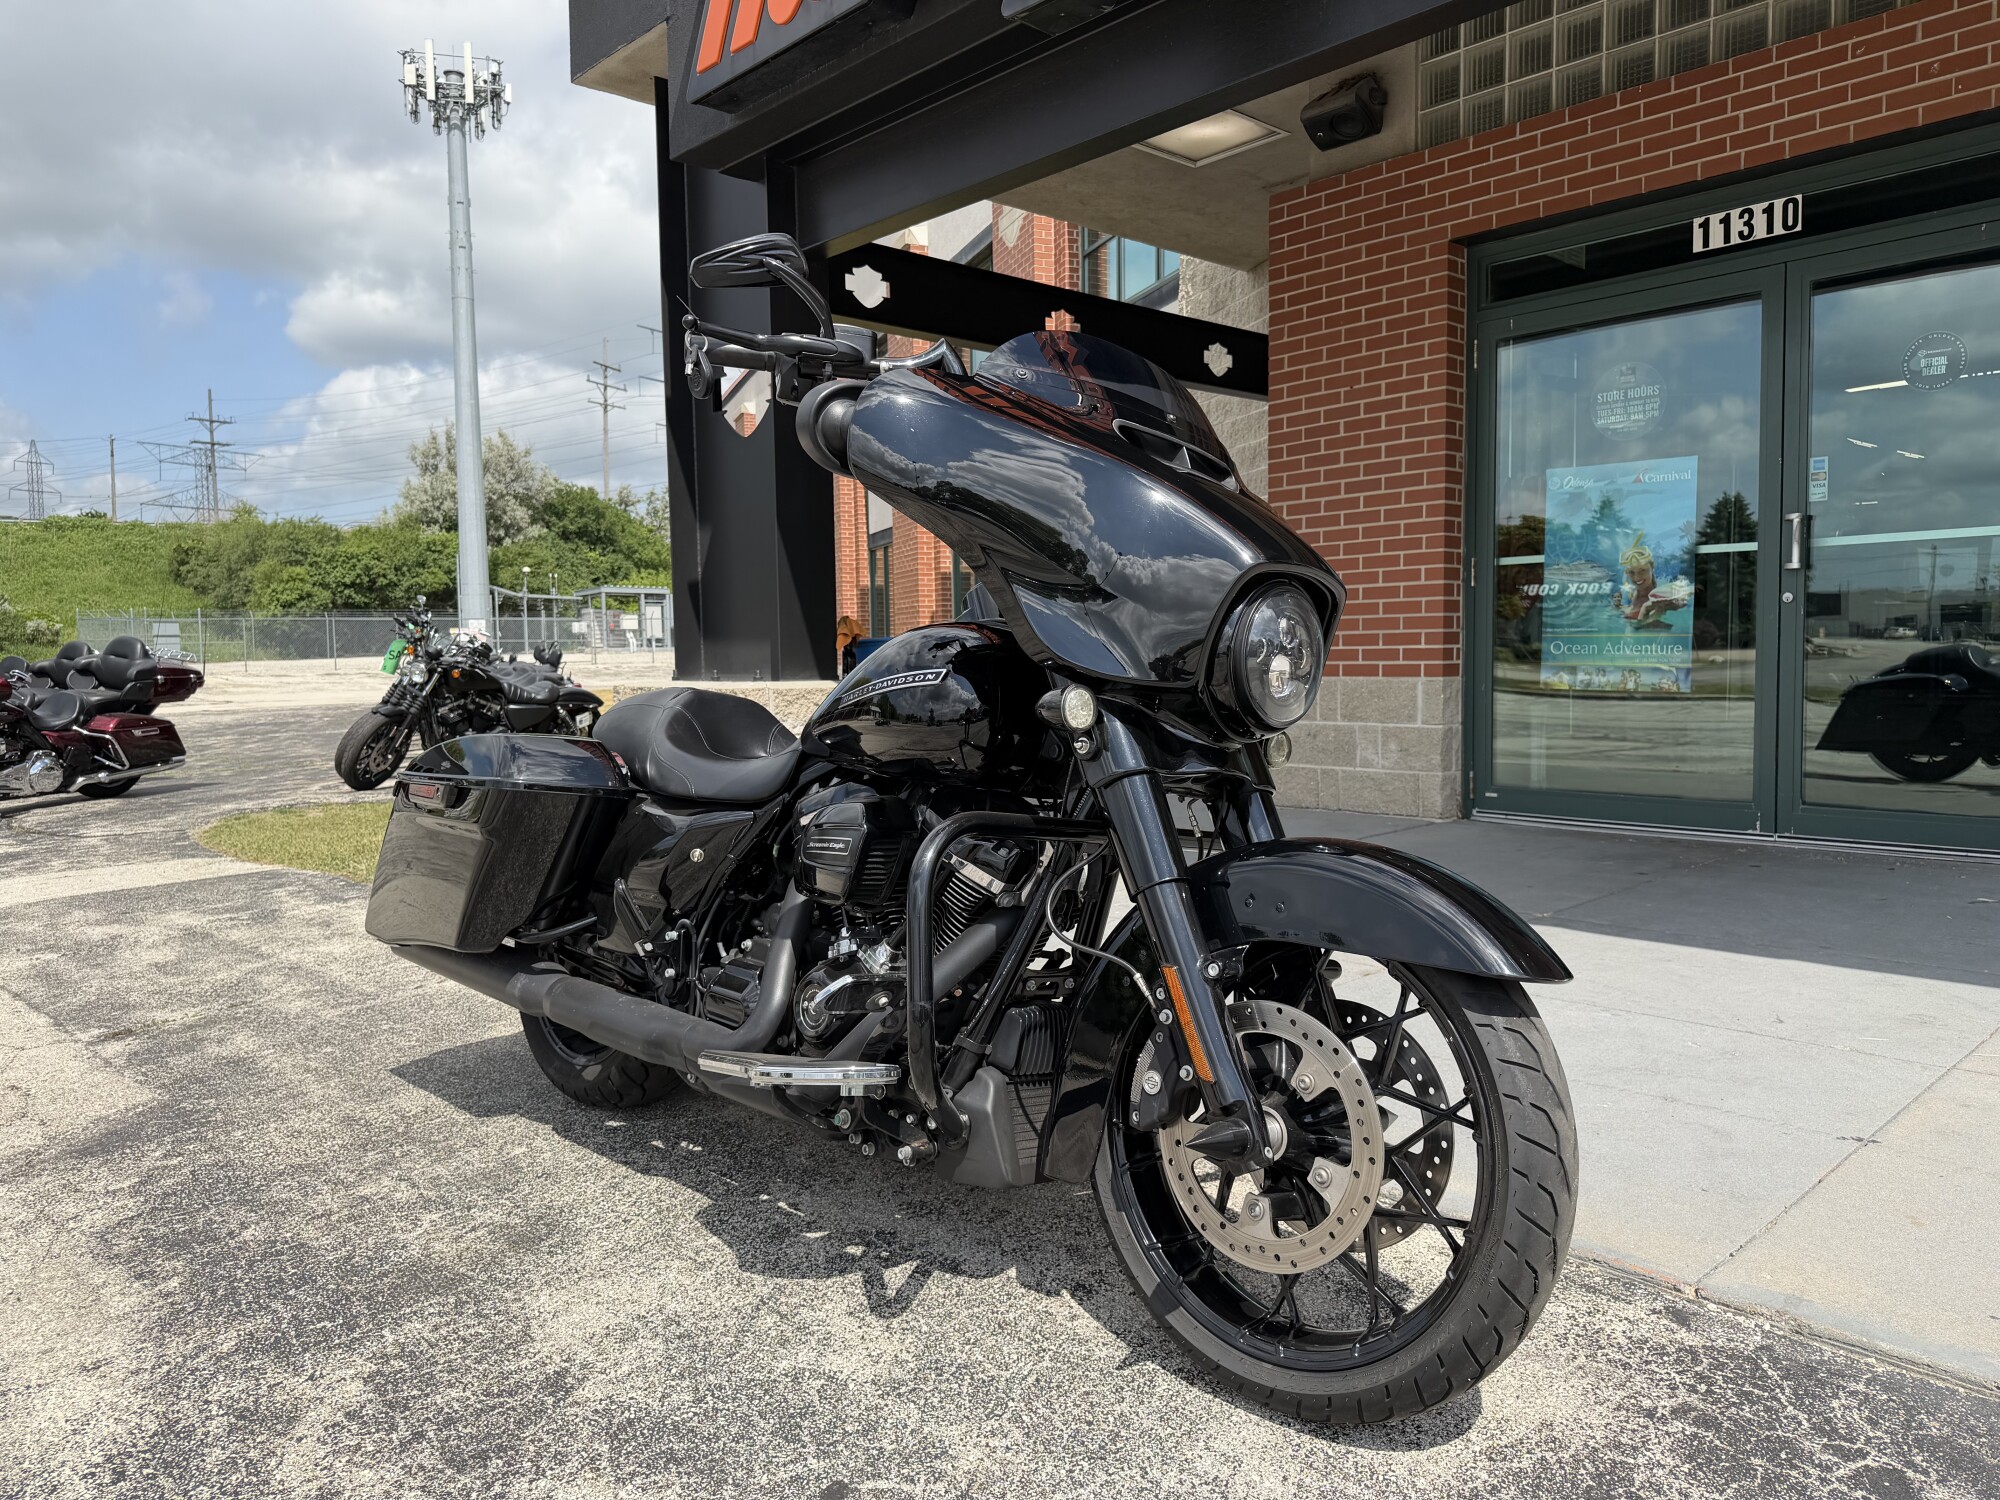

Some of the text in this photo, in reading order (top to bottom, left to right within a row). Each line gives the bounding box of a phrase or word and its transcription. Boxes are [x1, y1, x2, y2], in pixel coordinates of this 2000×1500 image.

[1698, 197, 1800, 249] 11310
[1920, 355, 1949, 368] OFFICIAL
[1922, 365, 1946, 377] DEALER
[1597, 384, 1660, 403] STORE HOURS
[1644, 470, 1691, 483] Carnival
[1550, 641, 1683, 656] Ocean Adventure
[842, 673, 936, 703] HARLEY-DAVIDSON
